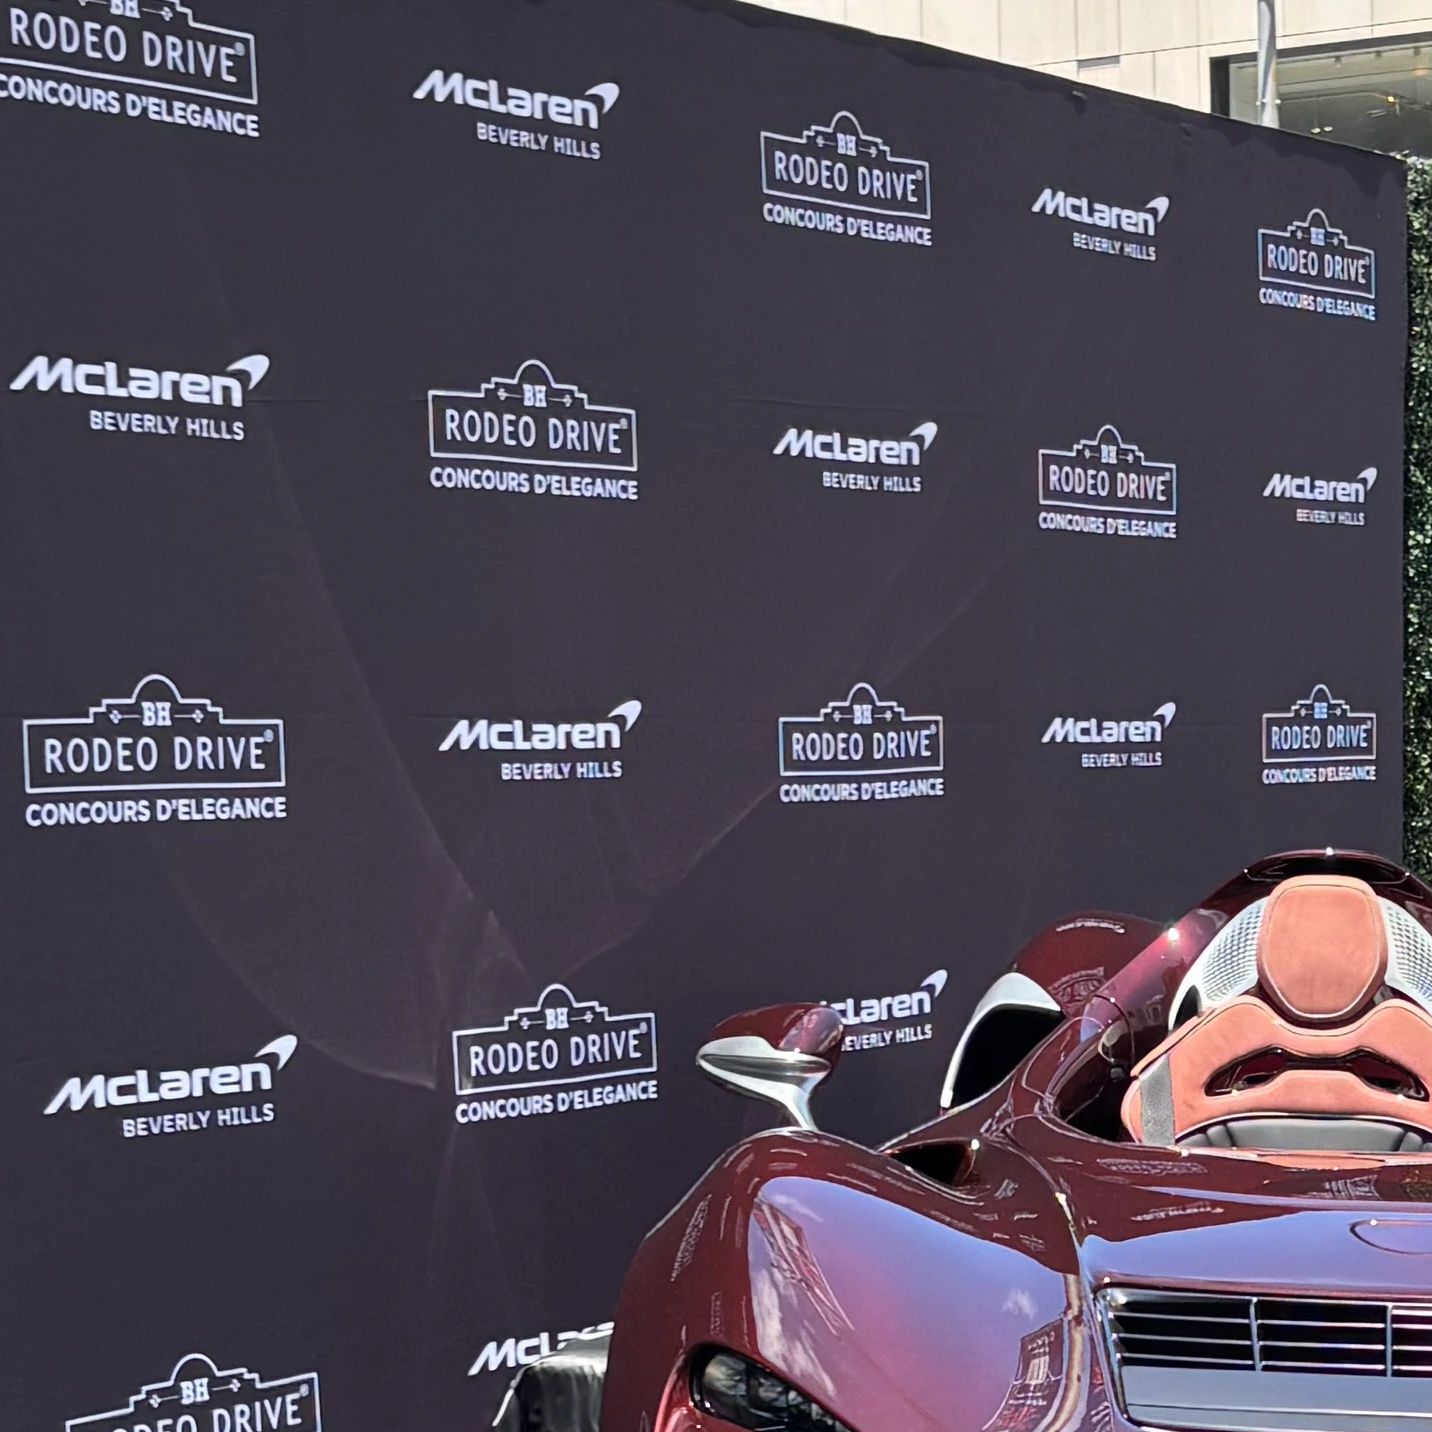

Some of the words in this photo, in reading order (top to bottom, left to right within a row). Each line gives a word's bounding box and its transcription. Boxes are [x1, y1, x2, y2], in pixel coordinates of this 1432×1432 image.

[11, 8, 126, 61] RODEO
[126, 93, 259, 137] D'ELEGANCE
[413, 70, 598, 129] McLaren
[477, 122, 548, 150] BEVERLY
[554, 137, 600, 159] HILLS
[837, 133, 857, 156] BH
[775, 151, 848, 191] RODEO
[763, 203, 844, 233] CONCOURS
[847, 217, 932, 246] D'ELEGANCE
[1032, 189, 1154, 236] McLaren
[1268, 244, 1318, 276] RODEO
[10, 356, 242, 407] McLaren
[523, 384, 547, 407] BH
[90, 410, 179, 434] BEVERLY
[187, 418, 244, 440] HILLS
[446, 409, 535, 447] RODEO
[773, 428, 920, 465] McLaren
[430, 467, 530, 493] CONCOURS
[534, 474, 638, 500] D'ELEGANCE
[823, 472, 877, 490] BEVERLY
[884, 476, 921, 492] HILLS
[1050, 465, 1109, 496] RODEO
[1263, 473, 1364, 503] McLaren
[141, 702, 172, 726] BH
[1041, 717, 1161, 743] McLaren
[439, 719, 620, 751] McLaren
[792, 733, 863, 761] RODEO
[1272, 726, 1321, 749] RODEO
[45, 737, 157, 773] RODEO
[501, 763, 571, 780] BEVERLY
[576, 761, 622, 778] HILLS
[780, 783, 859, 802] CONCOURS
[861, 778, 944, 800] D'ELEGANCE
[26, 800, 150, 826] CONCOURS
[156, 797, 287, 821] D'ELEGANCE
[545, 1007, 569, 1030] BH
[842, 1031, 892, 1051] EVERLY
[896, 1024, 932, 1042] HILLS
[470, 1039, 558, 1076] RODEO
[44, 1063, 271, 1114] McLaren
[456, 1094, 553, 1123] CONCOURS
[557, 1080, 657, 1111] D'ELEGANCE
[123, 1111, 210, 1137] BEVERLY
[217, 1103, 274, 1126] HILLS
[180, 1378, 209, 1404] BH
